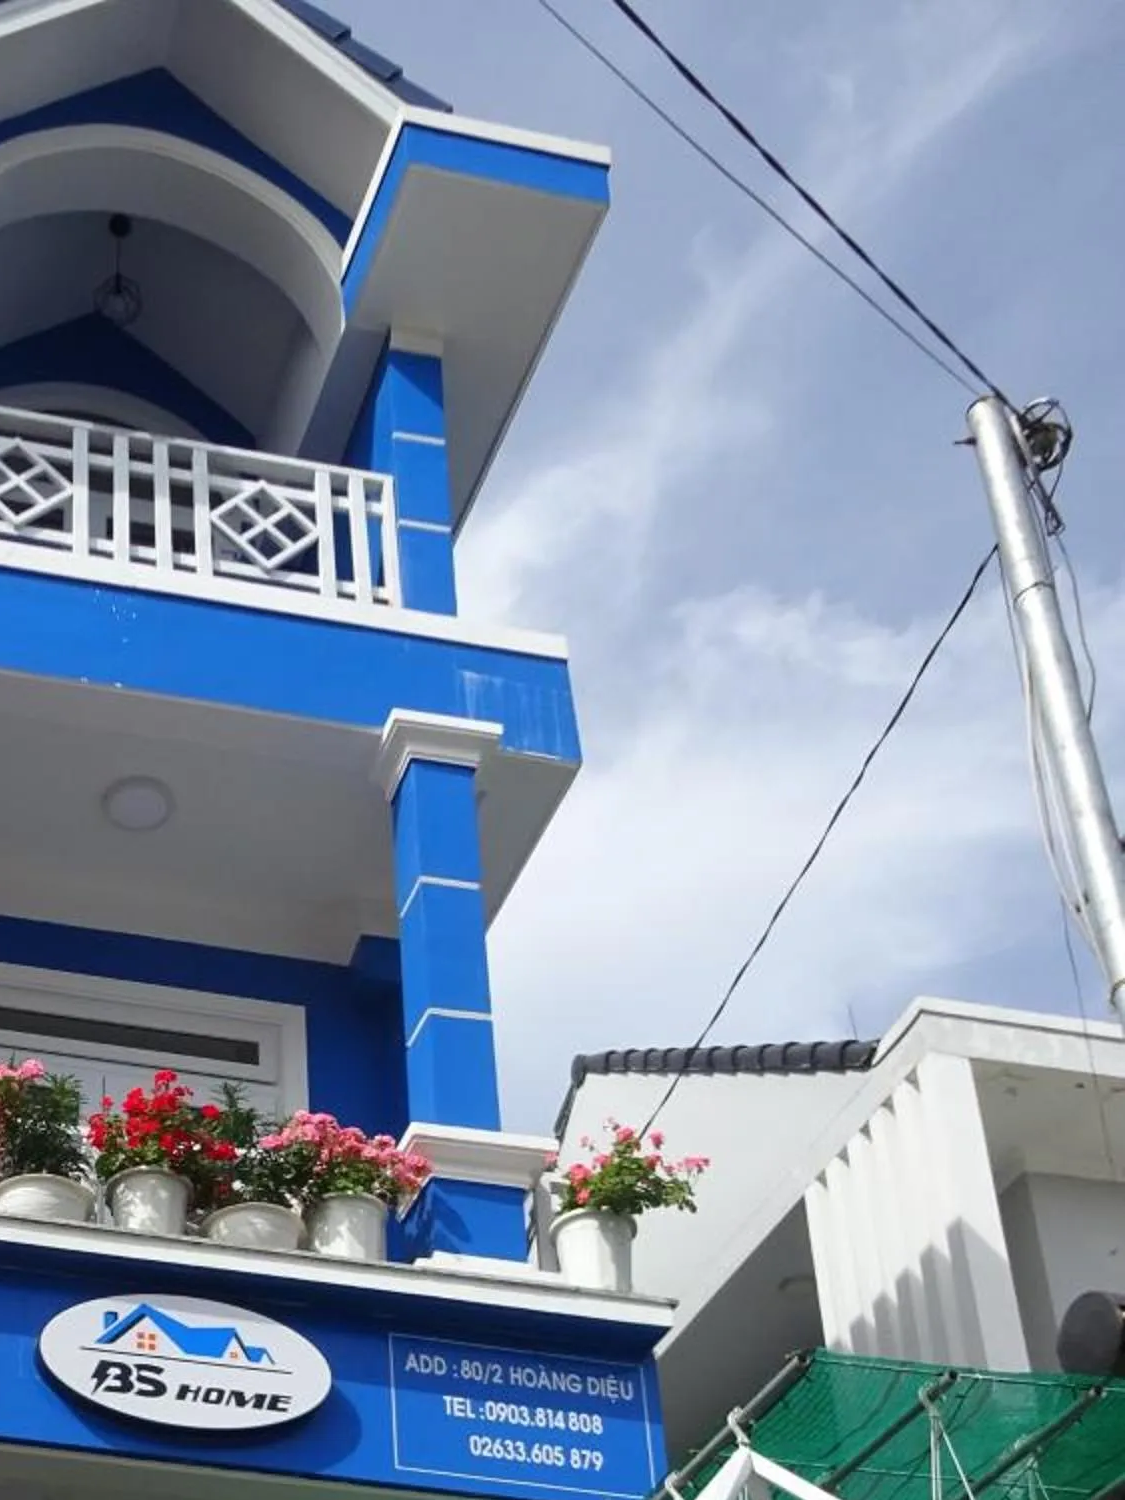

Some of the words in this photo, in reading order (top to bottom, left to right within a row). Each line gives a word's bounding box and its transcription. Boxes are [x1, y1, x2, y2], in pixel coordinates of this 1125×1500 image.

[91, 1360, 167, 1398] BS
[176, 1384, 293, 1412] HOME
[405, 1353, 447, 1376] ADD
[509, 1364, 583, 1393] HOÀNG
[586, 1374, 634, 1405] DIỆU
[469, 1435, 564, 1467] 02633.605
[570, 1448, 603, 1472] 879
